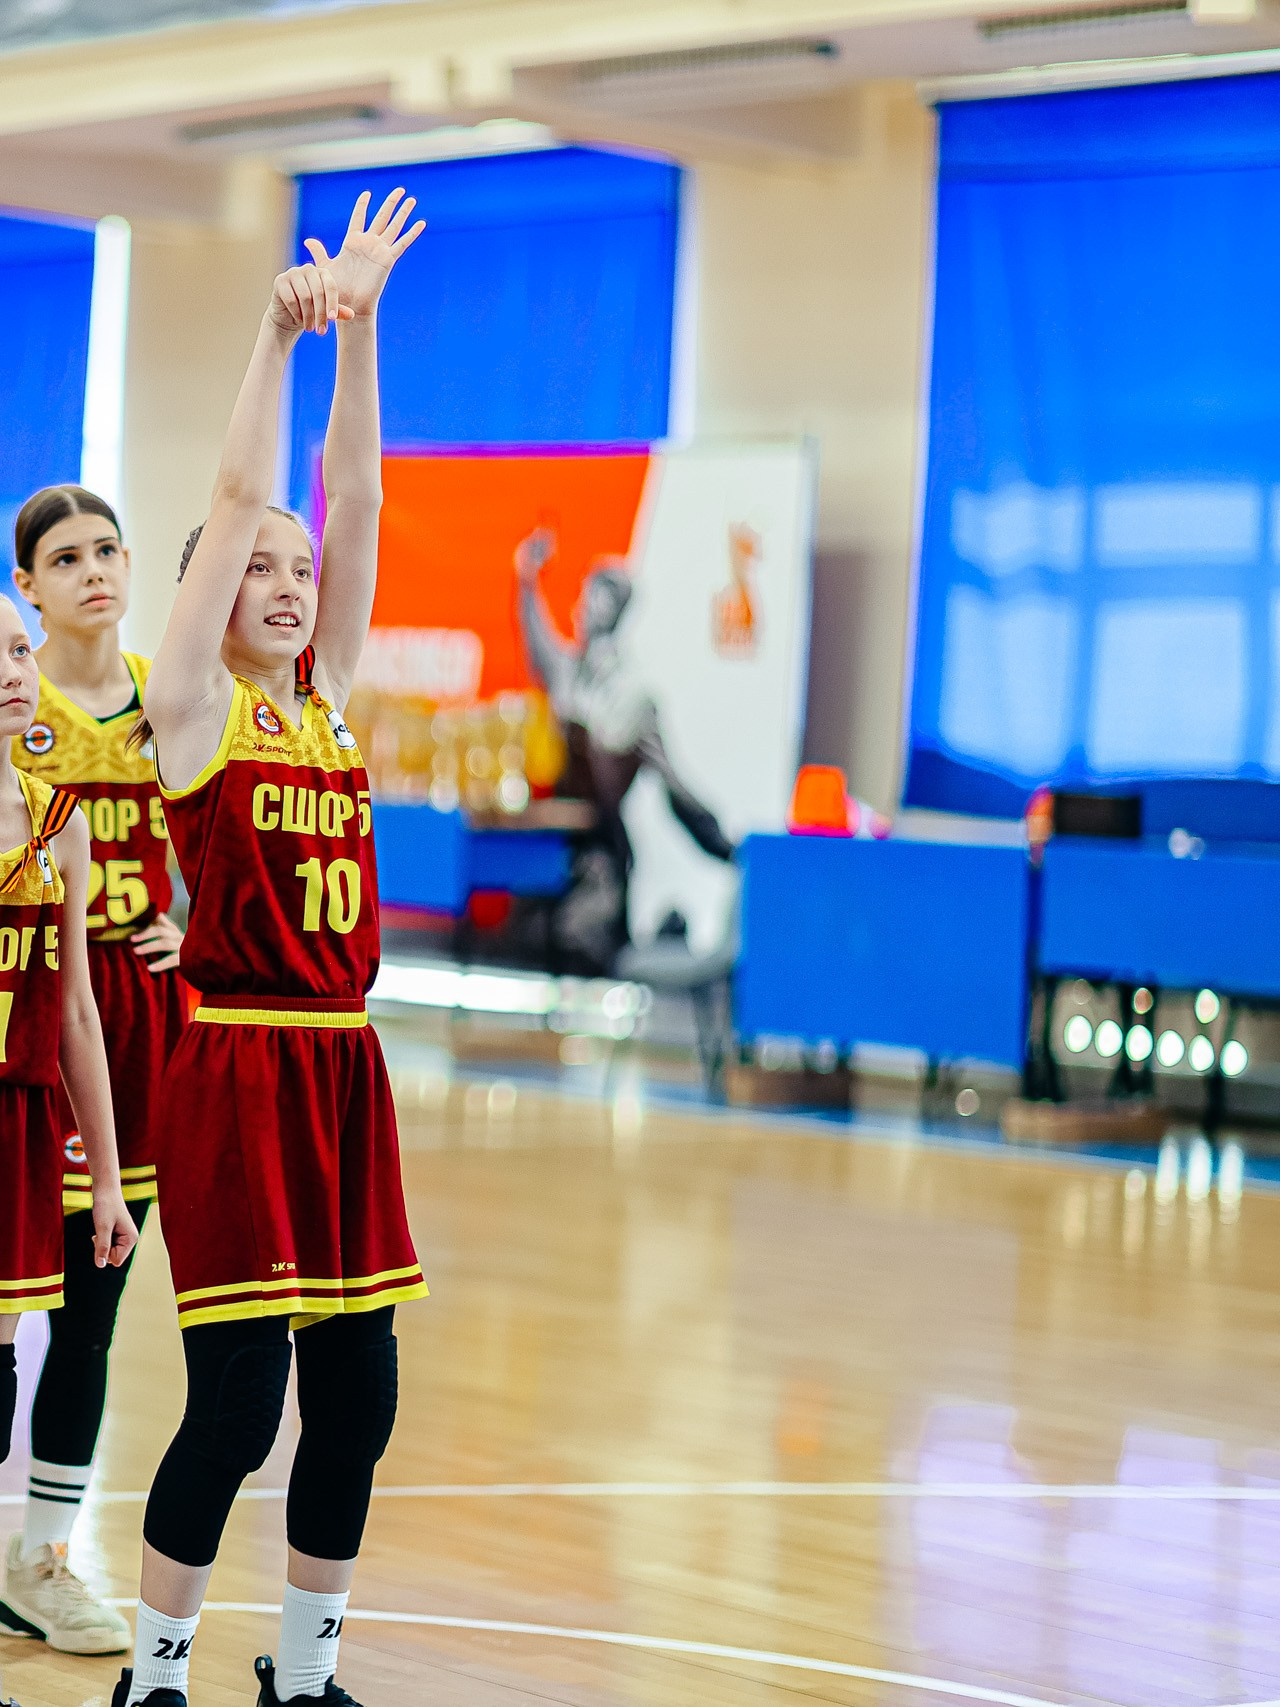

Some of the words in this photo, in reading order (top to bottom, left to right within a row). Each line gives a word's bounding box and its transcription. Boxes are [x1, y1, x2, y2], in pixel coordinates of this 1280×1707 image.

[266, 745, 292, 757] SPORT
[149, 796, 169, 840] 5
[253, 782, 355, 838] СШОР
[357, 790, 371, 837] 5
[86, 859, 150, 925] 25
[295, 856, 361, 935] 10
